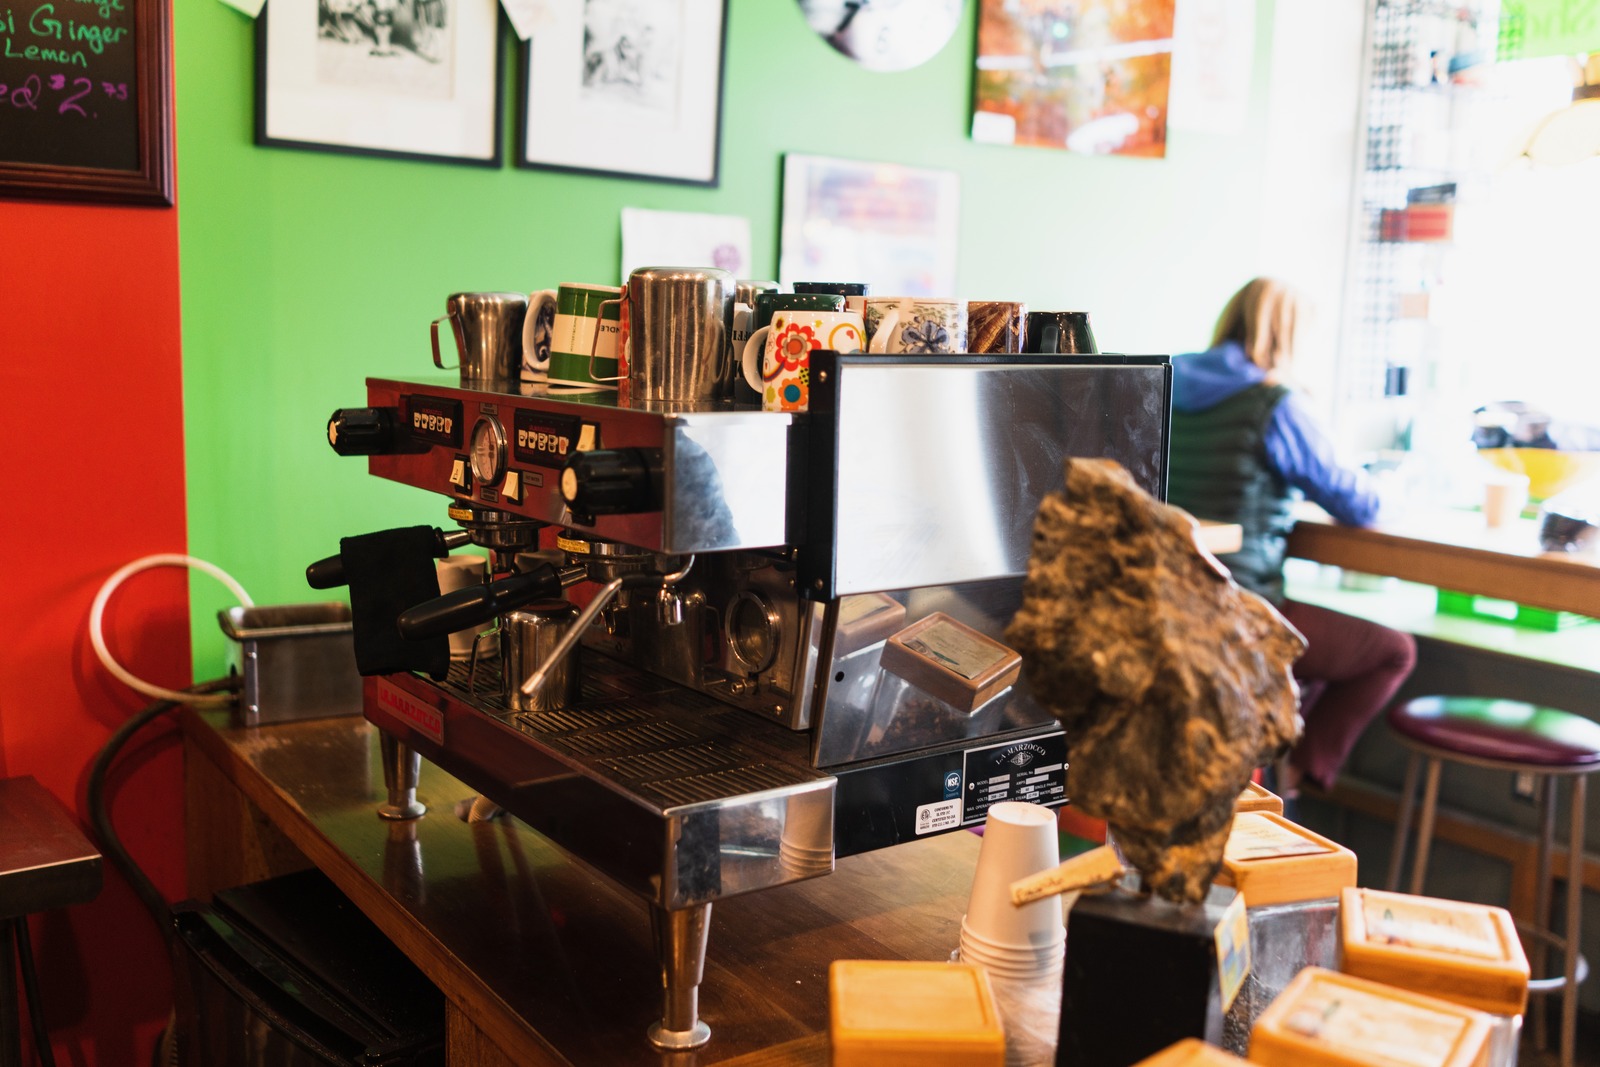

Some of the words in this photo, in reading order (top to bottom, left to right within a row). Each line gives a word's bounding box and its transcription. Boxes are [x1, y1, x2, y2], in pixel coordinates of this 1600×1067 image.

[29, 3, 128, 54] Ginger
[4, 38, 87, 68] Lemon
[600, 324, 620, 334] NDLE
[995, 754, 1006, 765] LA
[1007, 743, 1047, 756] MARZOCCO
[946, 776, 959, 788] NSF
